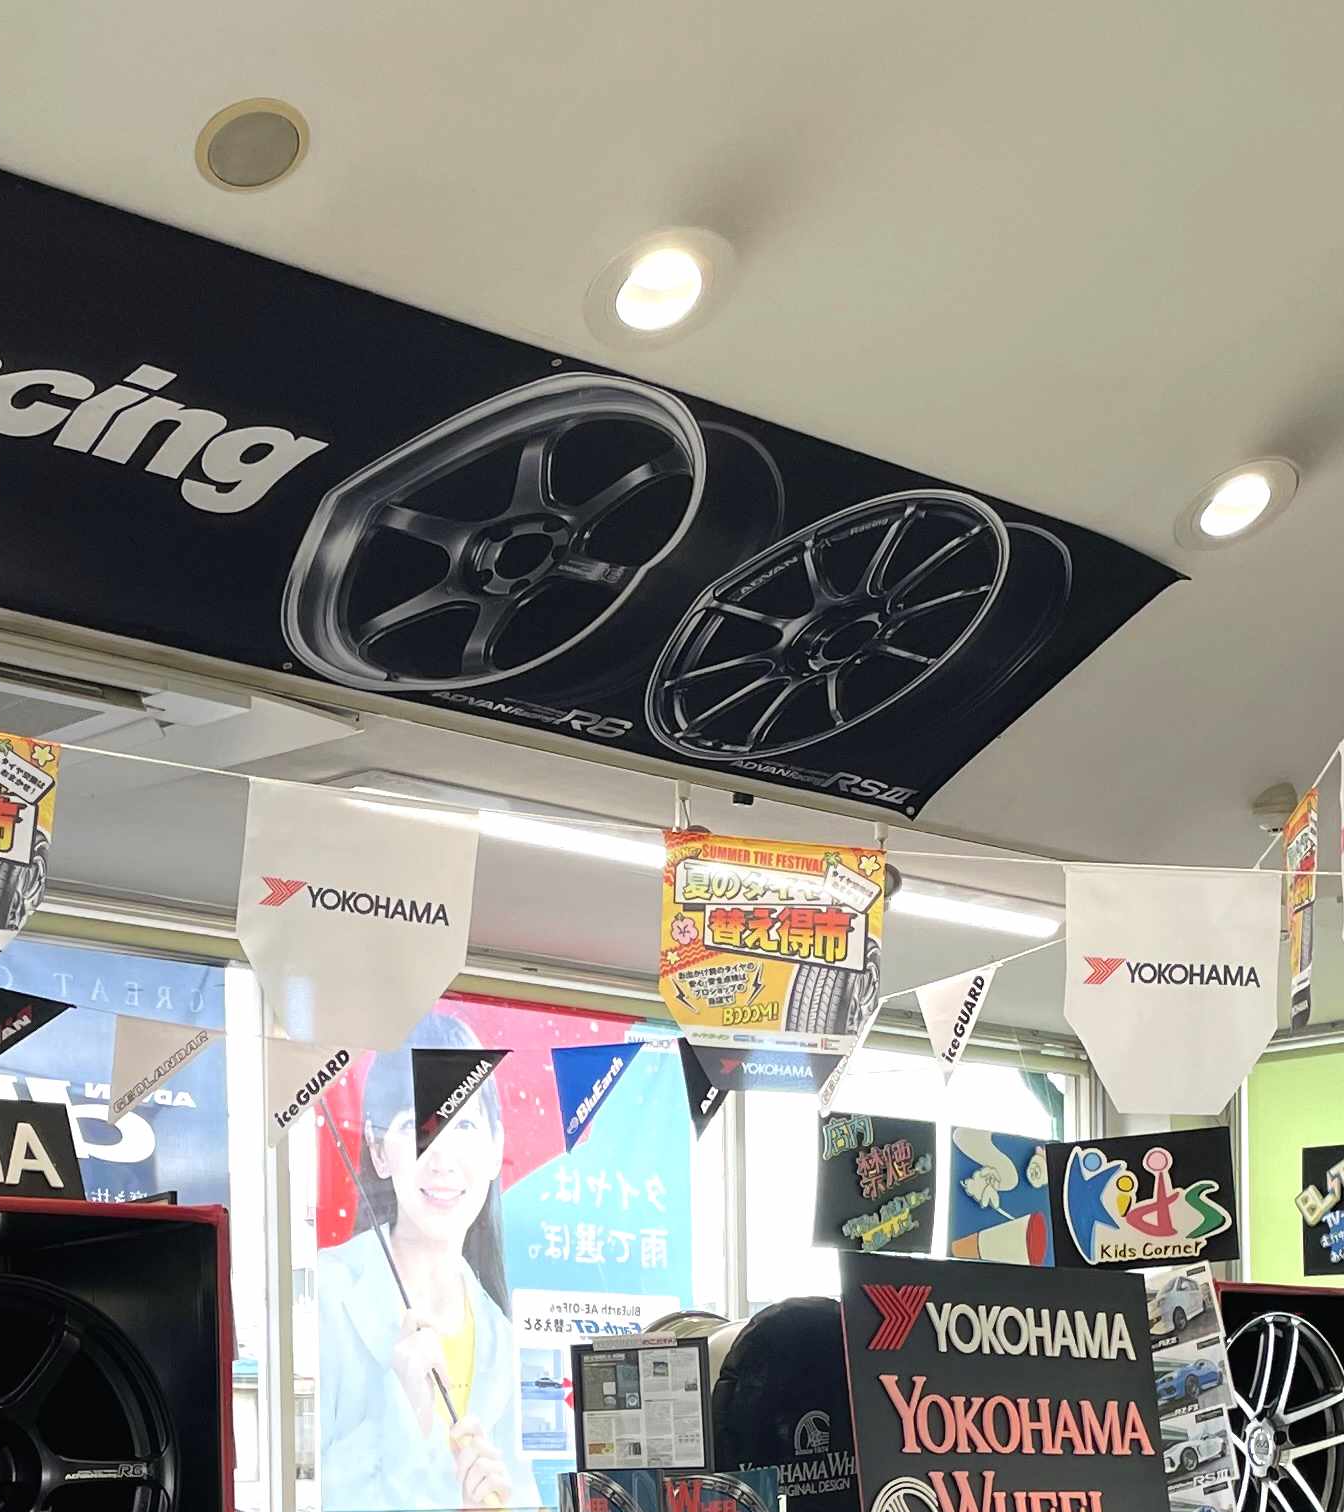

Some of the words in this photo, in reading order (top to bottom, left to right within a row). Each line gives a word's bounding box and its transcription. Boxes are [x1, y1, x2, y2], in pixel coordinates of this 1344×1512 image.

[701, 844, 751, 864] SUMMER
[753, 851, 774, 867] THE
[307, 884, 450, 926] YOKOHAMA
[709, 907, 856, 963] 替え得市
[1127, 960, 1261, 989] YOKOHAMA
[940, 975, 986, 1065] iceGUARD
[274, 1048, 350, 1129] iceGUARD
[436, 1058, 494, 1121] YOKOHAMA
[575, 1056, 625, 1124] BluEarth
[742, 1062, 814, 1079] YOKOHAMA
[1100, 1243, 1137, 1259] Kids
[1142, 1240, 1203, 1258] Corner
[926, 1300, 1137, 1361] YOKOHAMA
[878, 1373, 1156, 1457] YOKOHAMA
[818, 1477, 851, 1493] DESIGN
